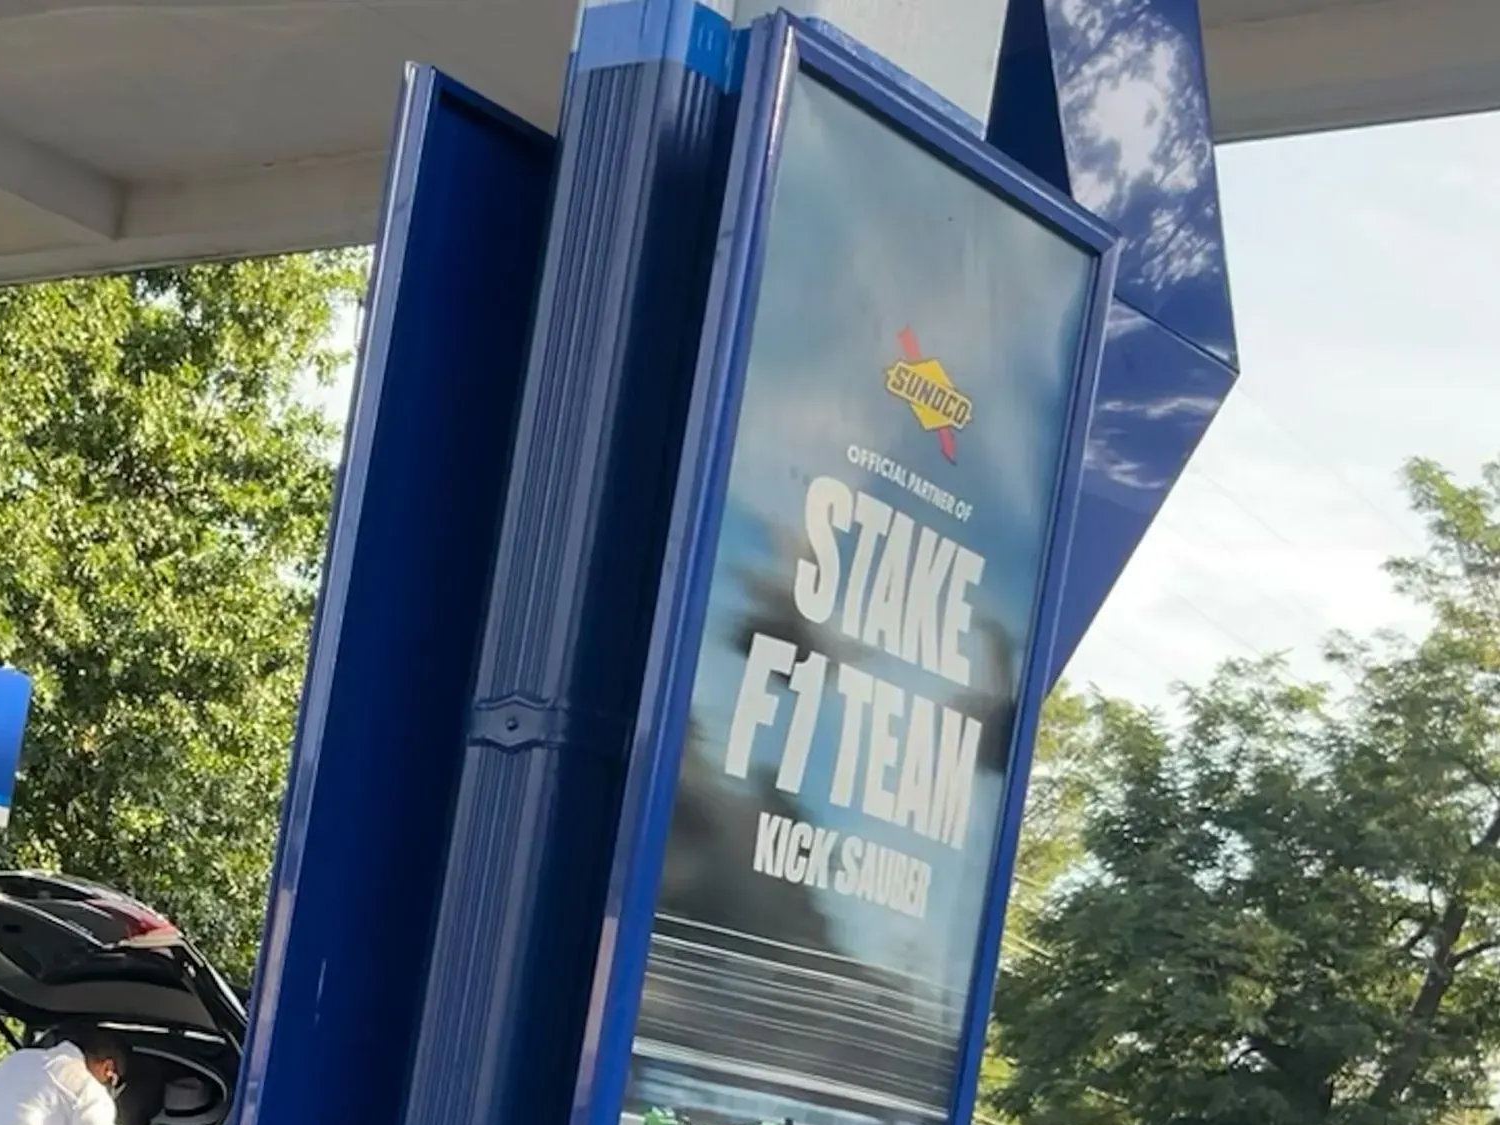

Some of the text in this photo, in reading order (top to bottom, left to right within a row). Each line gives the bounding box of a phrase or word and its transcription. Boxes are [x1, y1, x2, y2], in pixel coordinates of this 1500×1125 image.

[890, 366, 971, 425] SUNOCO
[846, 444, 974, 522] OFFICIAL PARTNER OF
[794, 475, 985, 687] STAKE
[724, 632, 983, 851] F1 TEAM
[753, 811, 840, 889] KICK
